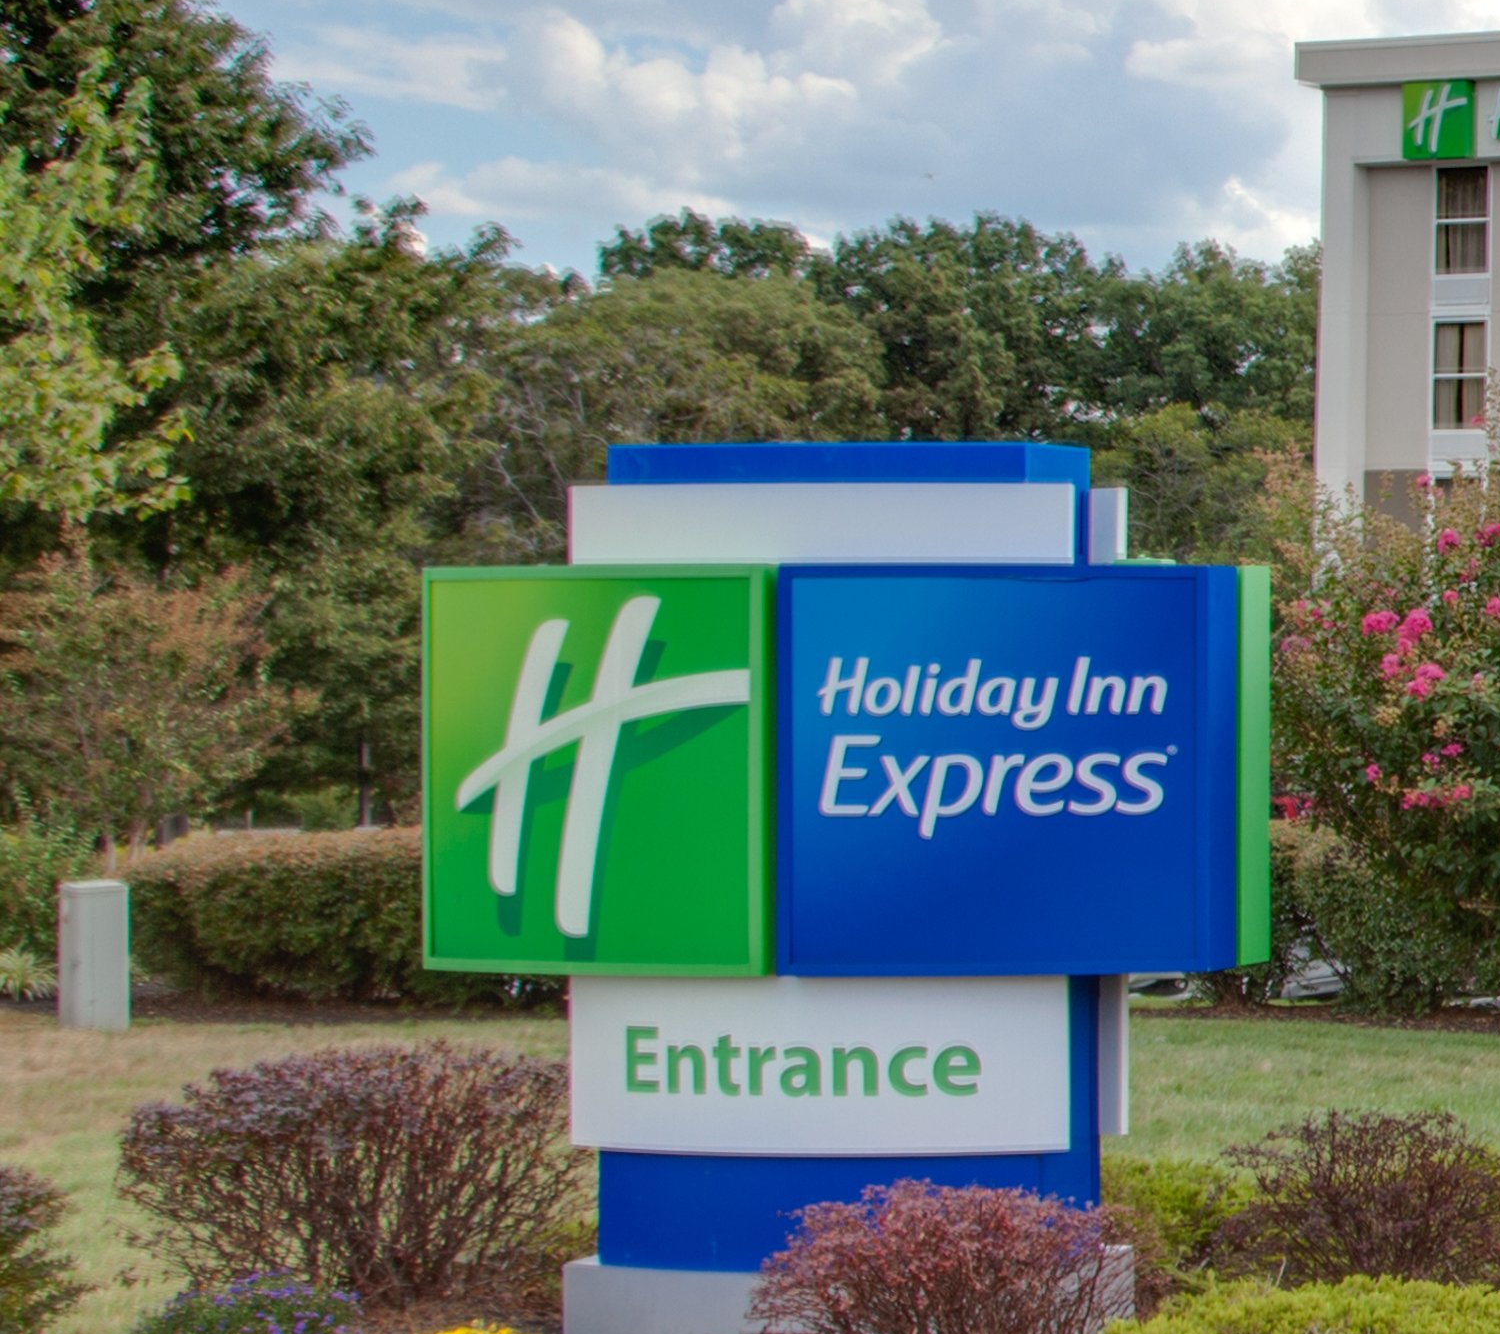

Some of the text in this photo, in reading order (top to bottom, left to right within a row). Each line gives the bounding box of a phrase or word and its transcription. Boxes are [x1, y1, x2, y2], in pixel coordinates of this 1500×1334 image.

[817, 656, 1168, 730] Holiday Inn
[818, 734, 1169, 840] Express
[625, 1025, 982, 1098] Entrance
